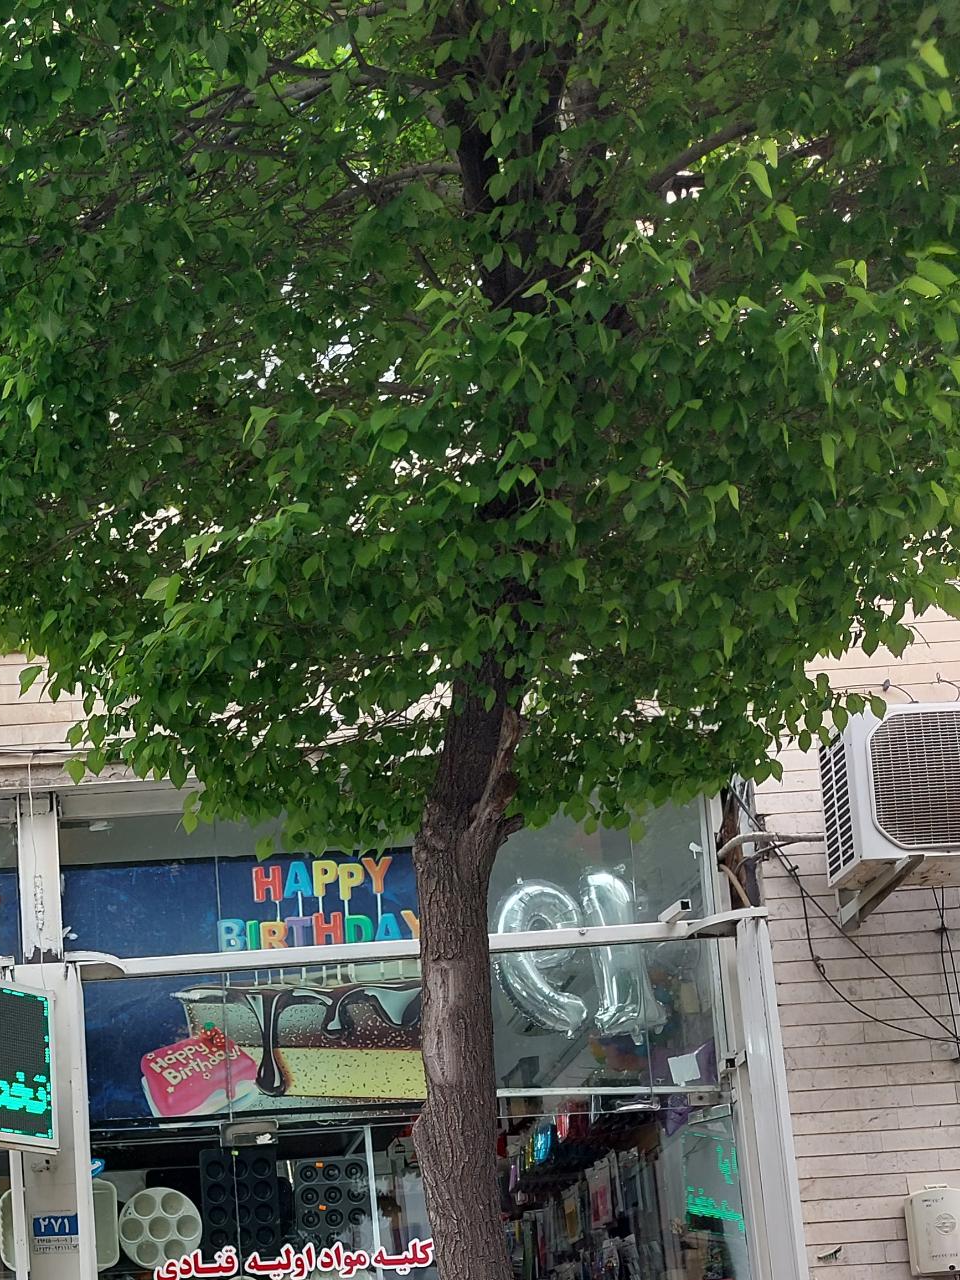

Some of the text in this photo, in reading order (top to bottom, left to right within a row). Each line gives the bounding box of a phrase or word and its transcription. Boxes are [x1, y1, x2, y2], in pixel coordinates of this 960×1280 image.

[252, 856, 392, 902] HAPPY
[150, 1040, 211, 1074] Happy
[39, 1217, 70, 1233] ۲۷۱
[244, 1242, 317, 1280] اولیه
[317, 1243, 369, 1277] مواد
[371, 1239, 436, 1274] کلیه
